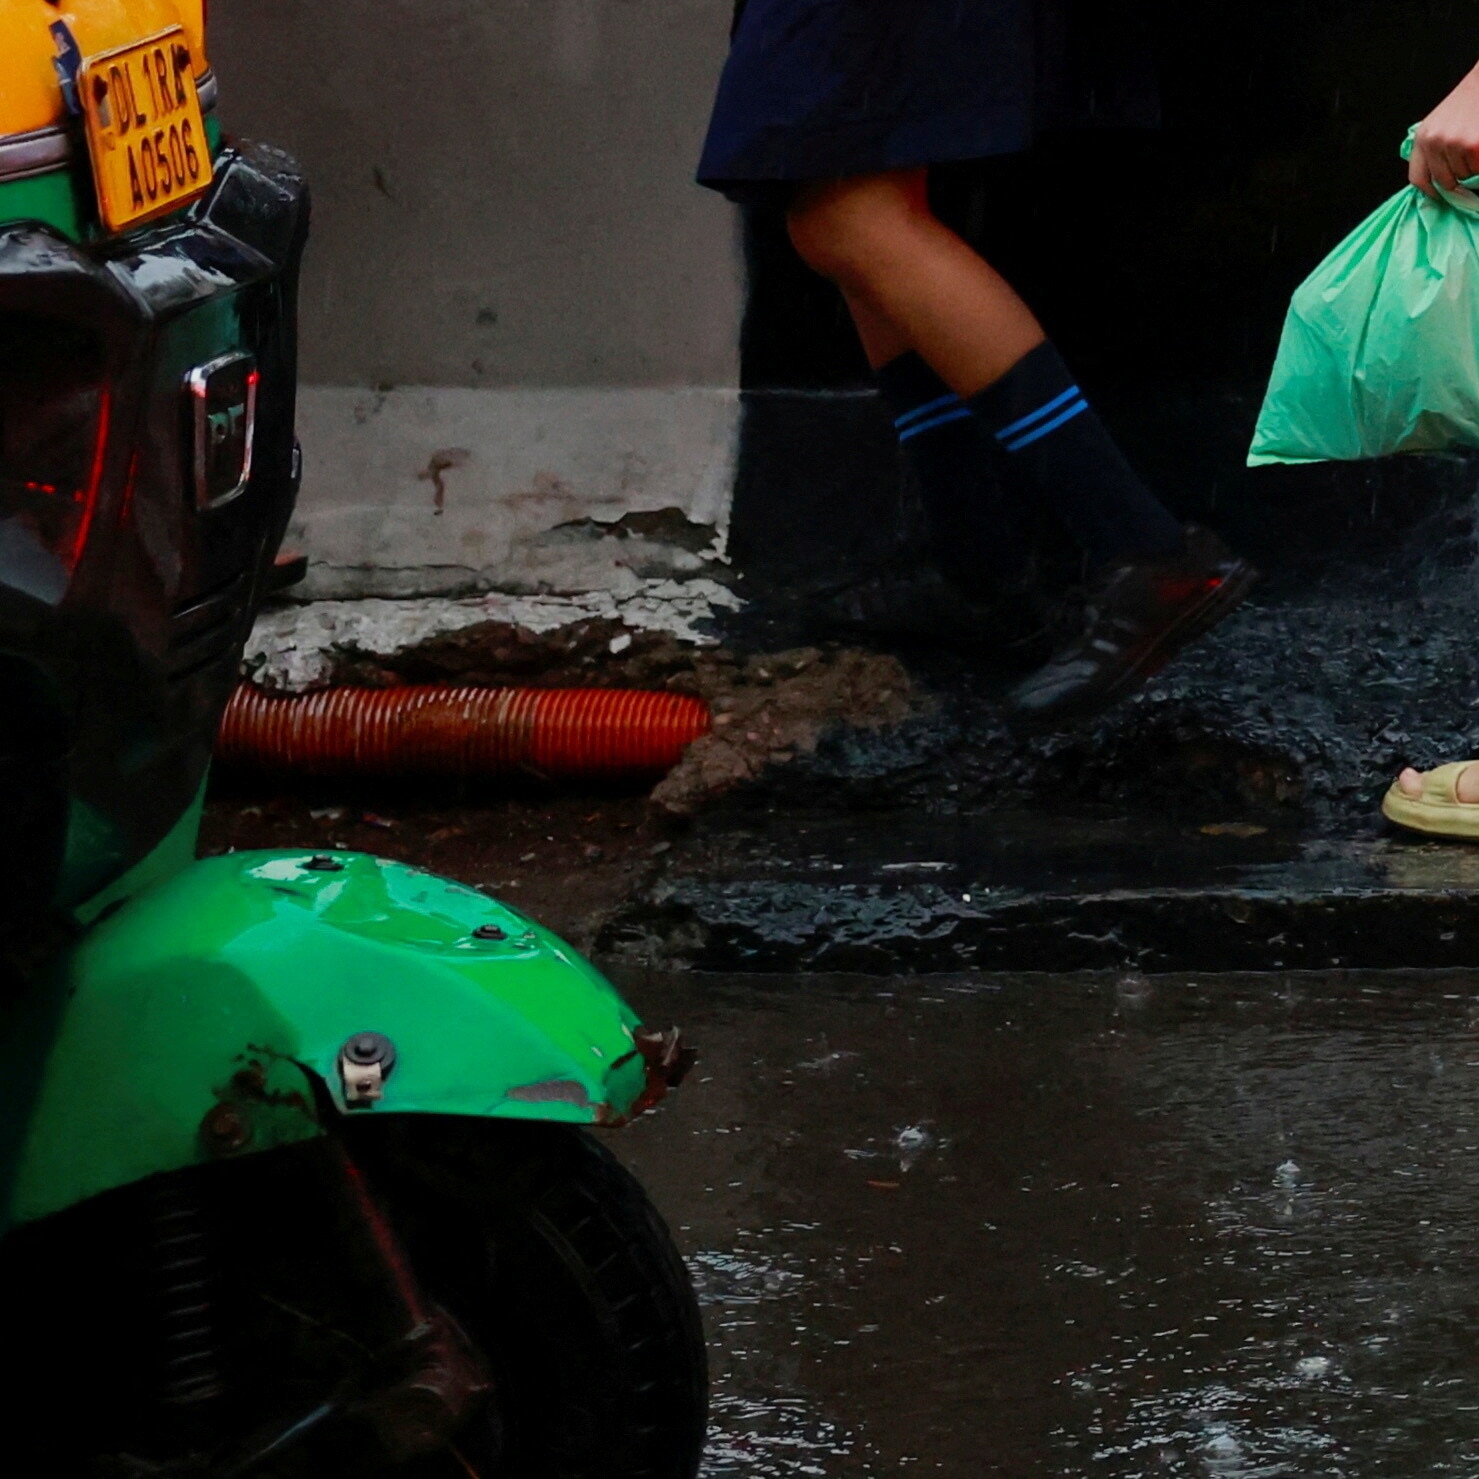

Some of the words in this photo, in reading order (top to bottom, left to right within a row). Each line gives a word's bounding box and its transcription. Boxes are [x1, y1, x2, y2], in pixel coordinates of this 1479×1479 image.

[109, 62, 147, 136] DL
[143, 43, 188, 120] 1RA
[127, 118, 199, 210] A0506
